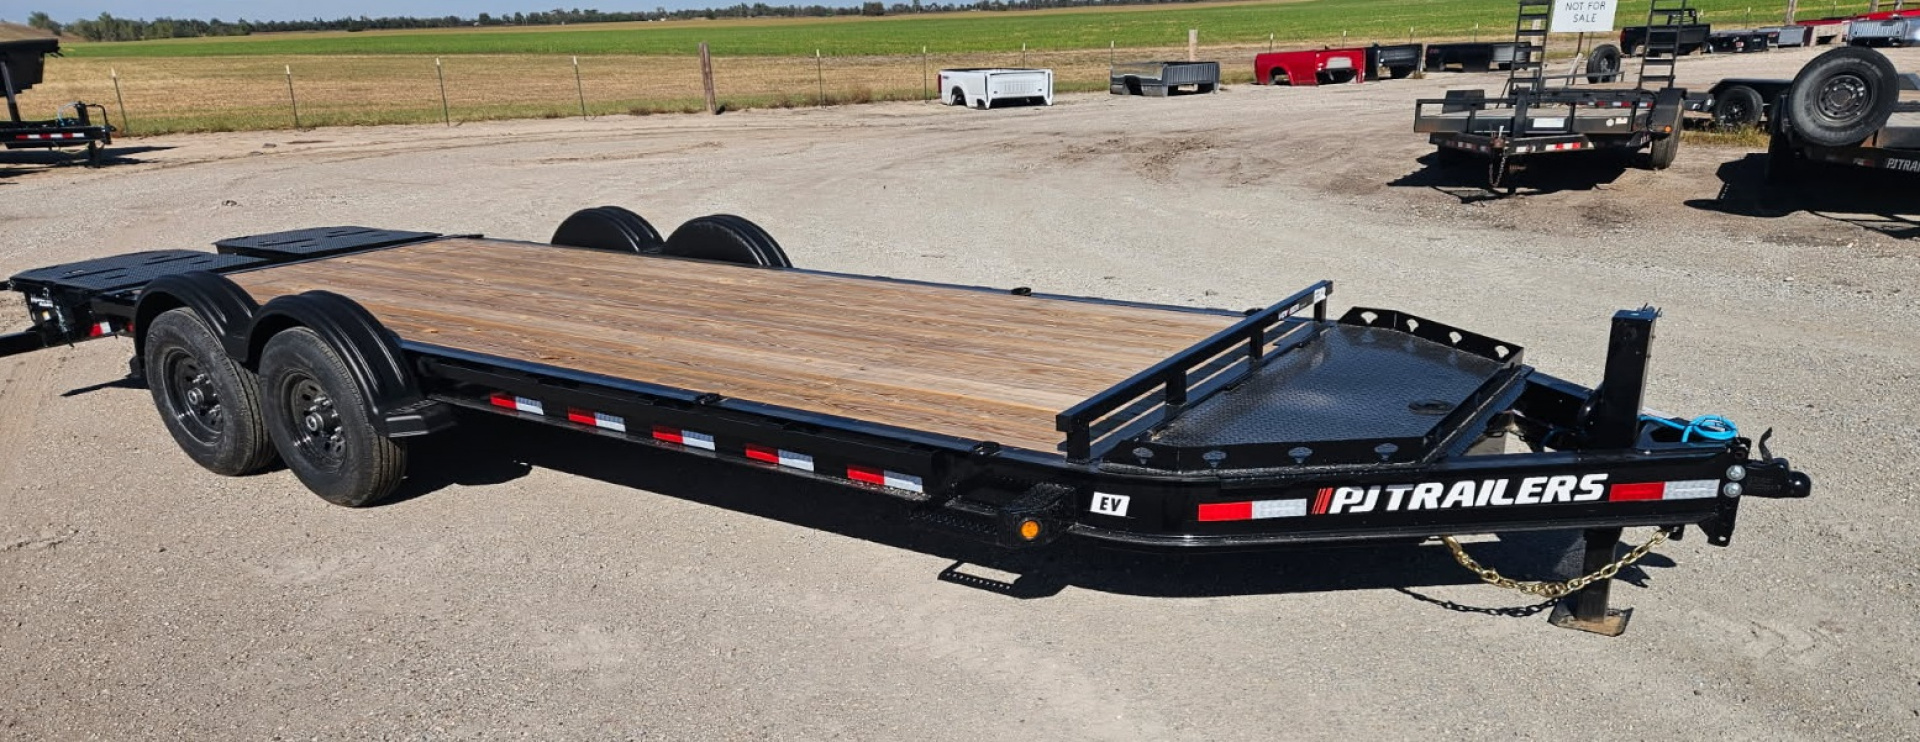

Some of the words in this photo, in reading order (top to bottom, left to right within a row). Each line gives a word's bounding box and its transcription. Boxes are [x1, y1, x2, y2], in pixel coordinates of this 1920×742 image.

[1565, 2, 1584, 11] NOT
[1587, 1, 1606, 10] FOR
[1572, 13, 1597, 22] SALE
[1886, 157, 1899, 169] PJ
[1328, 485, 1382, 515] PJ
[1385, 473, 1609, 511] TRAILERS
[1100, 496, 1122, 512] EV
